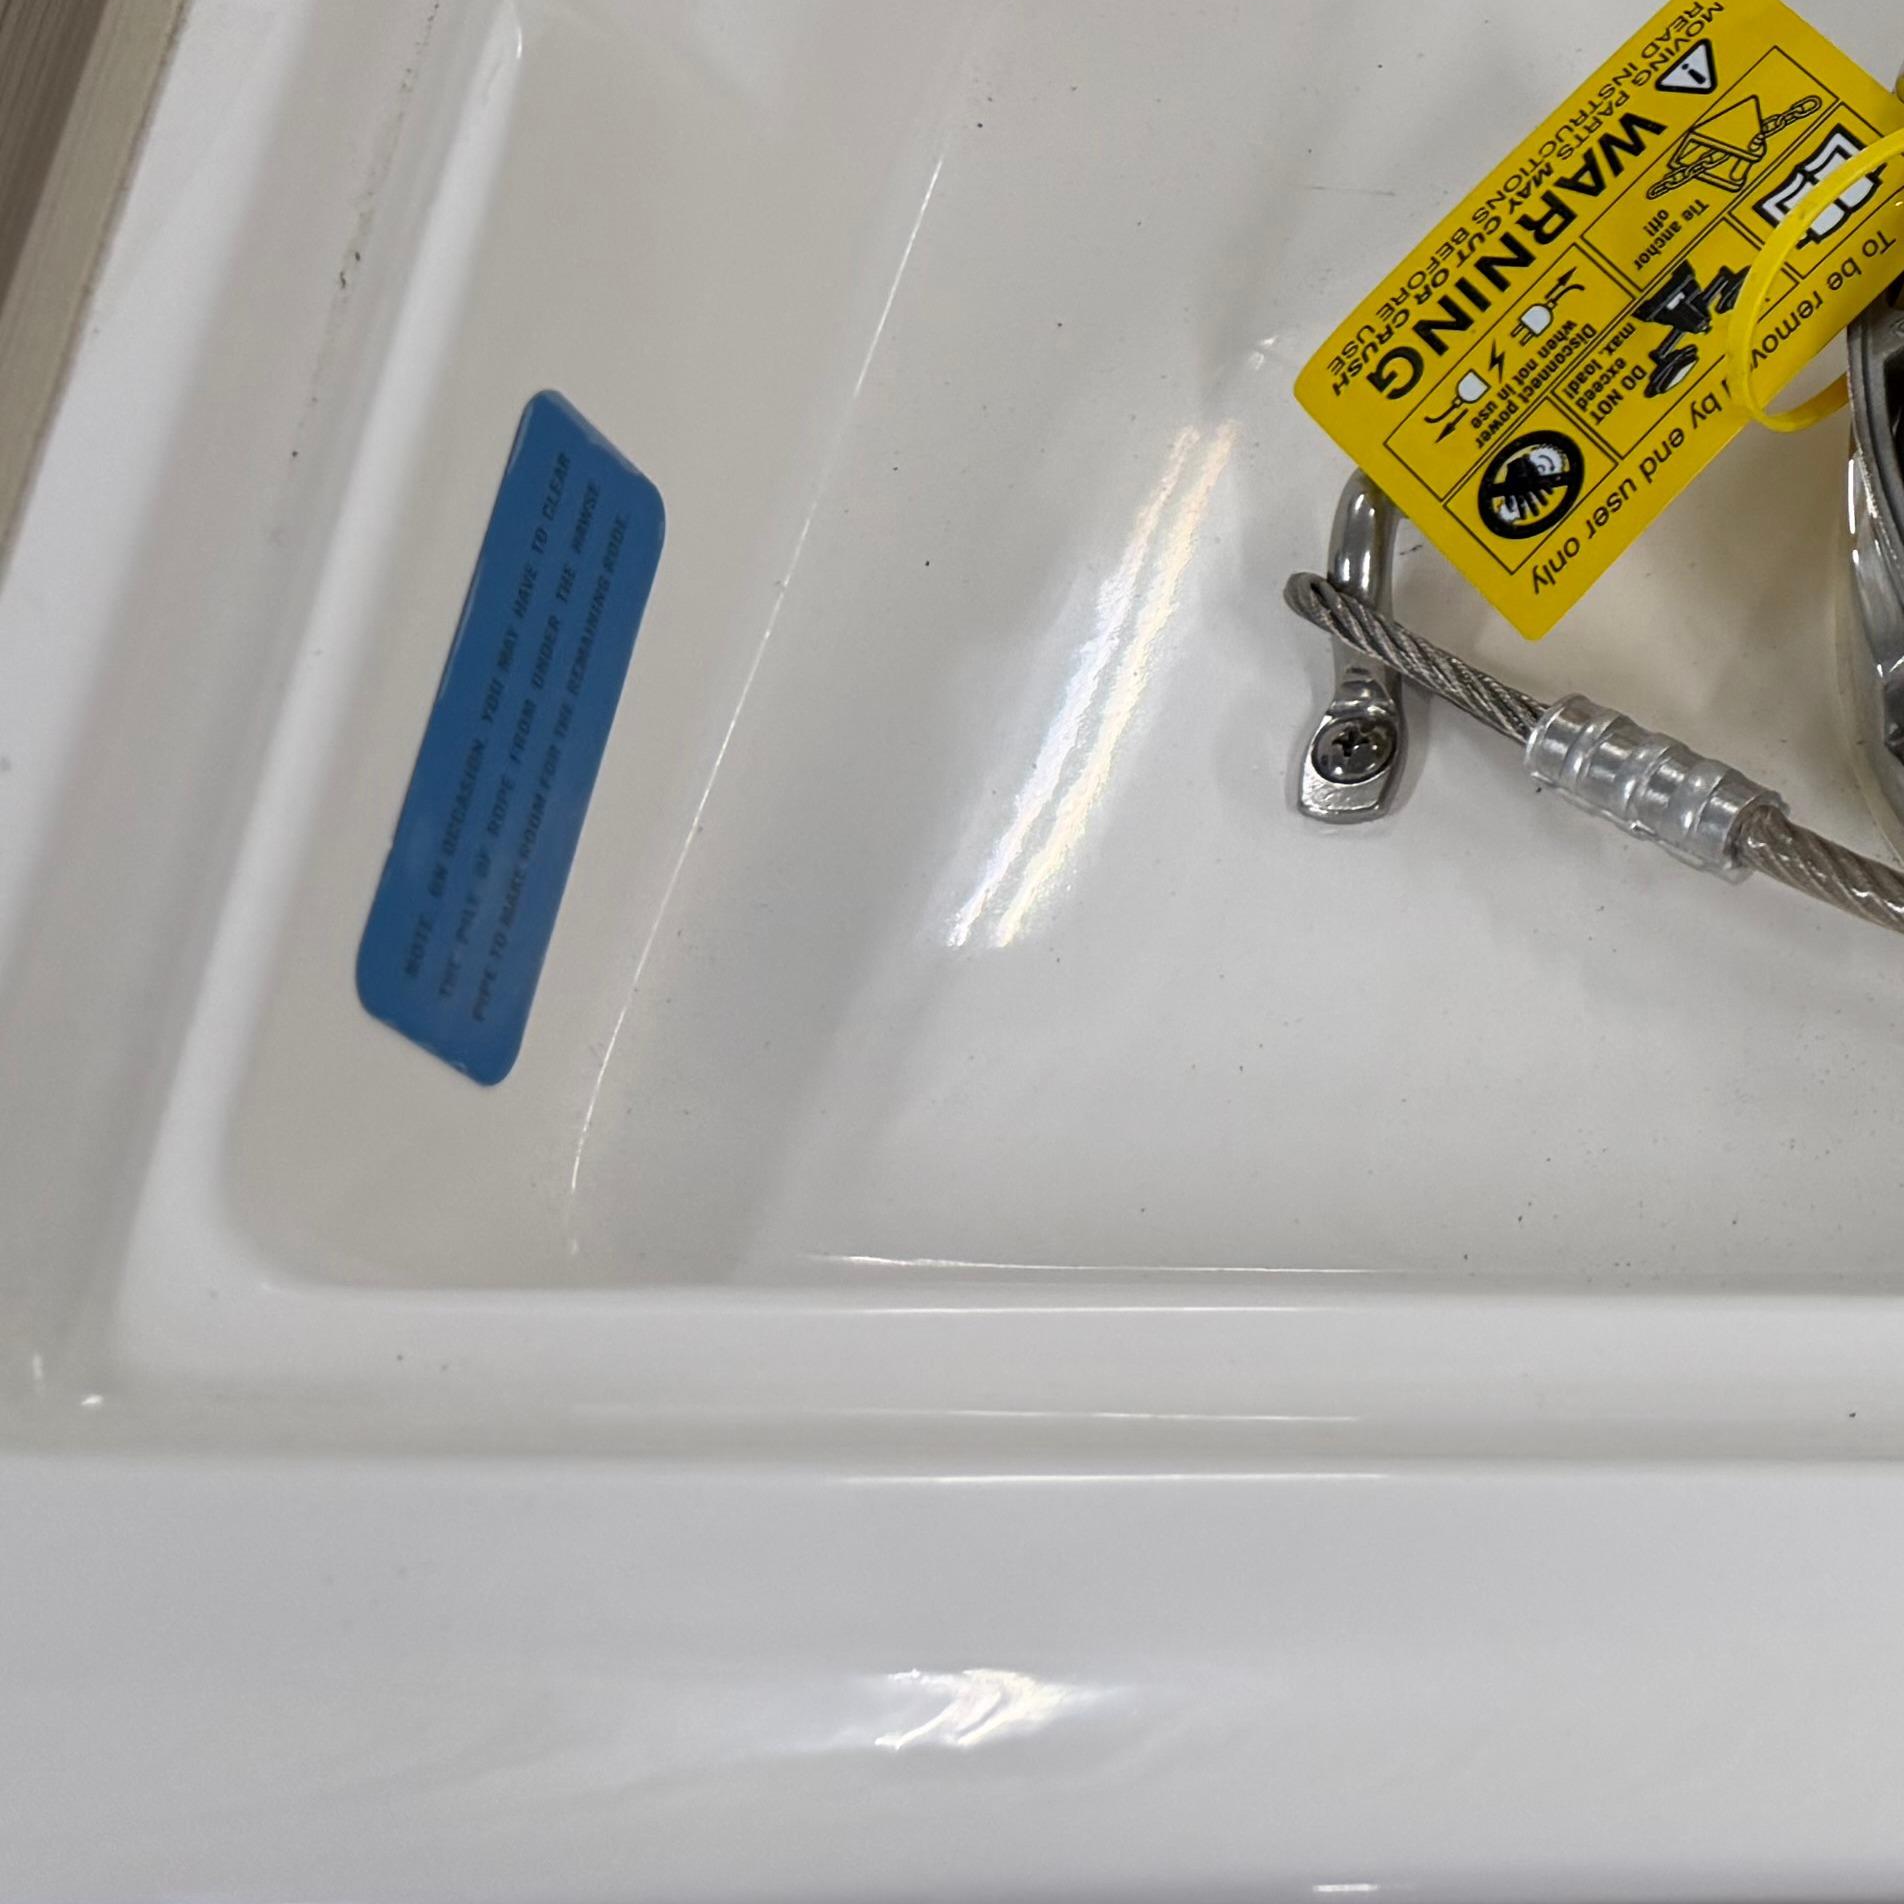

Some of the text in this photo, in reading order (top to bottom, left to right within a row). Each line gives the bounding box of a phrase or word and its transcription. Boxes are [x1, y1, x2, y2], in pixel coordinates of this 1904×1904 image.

[1327, 1, 1705, 376] READ INSTRUCTIONS BEFORE USE
[1332, 1, 1725, 397] MOVING PARTS MAY CUT OR CRUSH
[1633, 199, 1710, 271] Tie anchor
[1643, 209, 1669, 237] off!
[1861, 230, 1897, 258] To
[1366, 112, 1668, 401] WARNING
[1826, 256, 1863, 291] be
[1470, 320, 1578, 429] when not in use
[1475, 323, 1598, 449] Disconnect power
[1562, 322, 1637, 400] max. load!
[1574, 357, 1627, 413] exceed
[1589, 364, 1648, 426] DO NOT
[1690, 392, 1723, 430] by
[1638, 427, 1685, 483] end
[531, 526, 548, 555] TO
[541, 452, 571, 521] CLEAR
[1585, 478, 1638, 540] user
[1532, 536, 1581, 595] only
[489, 931, 508, 959] TO
